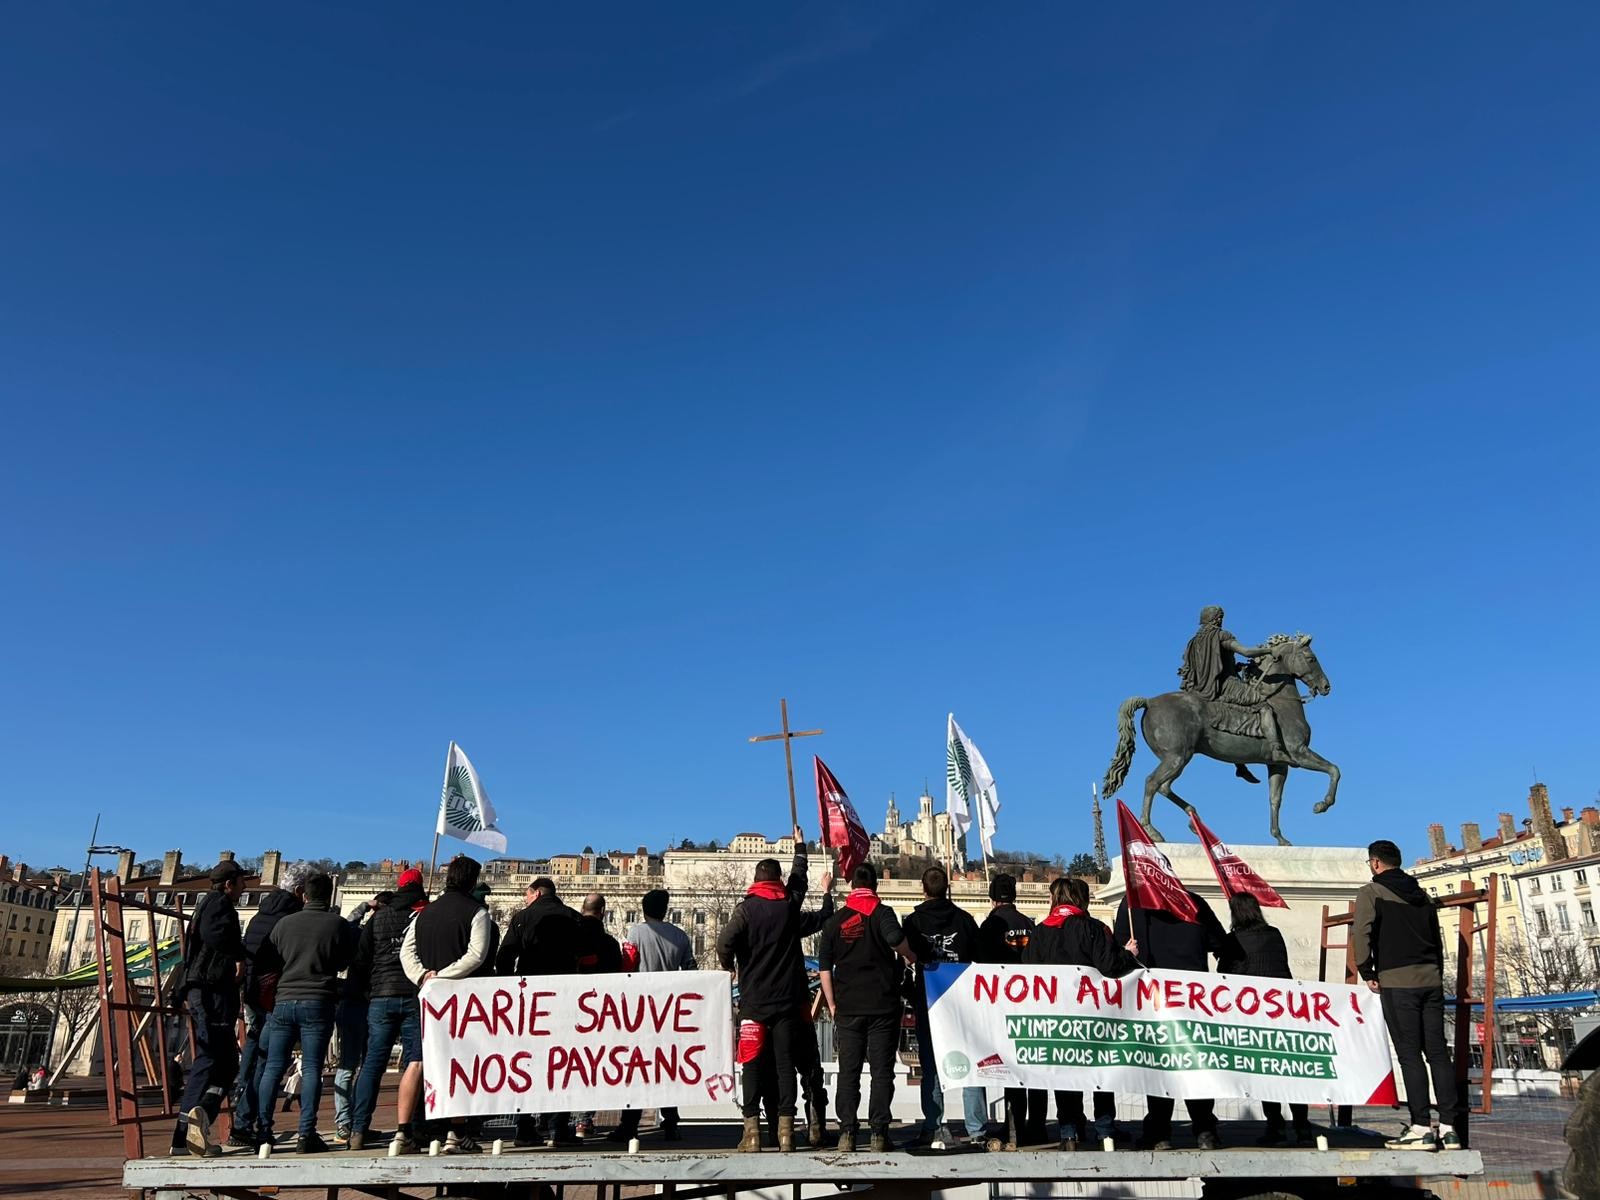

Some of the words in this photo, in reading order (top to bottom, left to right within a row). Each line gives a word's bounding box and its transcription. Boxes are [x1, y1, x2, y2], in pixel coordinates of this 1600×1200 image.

[421, 978, 556, 1040] MARIE
[575, 988, 704, 1033] SAUVE
[974, 974, 1057, 1004] NON
[1077, 975, 1122, 1010] AU
[1137, 978, 1340, 1027] MERCOSUR
[1350, 992, 1365, 1024] !
[1007, 1019, 1128, 1041] N'IMPORTONS
[1132, 1022, 1169, 1044] PAS
[1174, 1022, 1335, 1053] L'ALIMENTATION
[449, 1051, 532, 1098] NOS
[547, 1044, 706, 1091] PAYSANS
[1017, 1046, 1048, 1064] QUE
[1052, 1048, 1093, 1064] NOUS
[1098, 1049, 1119, 1064] NE
[1122, 1049, 1192, 1069] VOULONS
[1198, 1053, 1229, 1068] PAS
[1234, 1056, 1255, 1071] EN
[1261, 1057, 1325, 1076] FRANCE
[1329, 1062, 1336, 1077] !
[705, 1073, 734, 1101] FD
